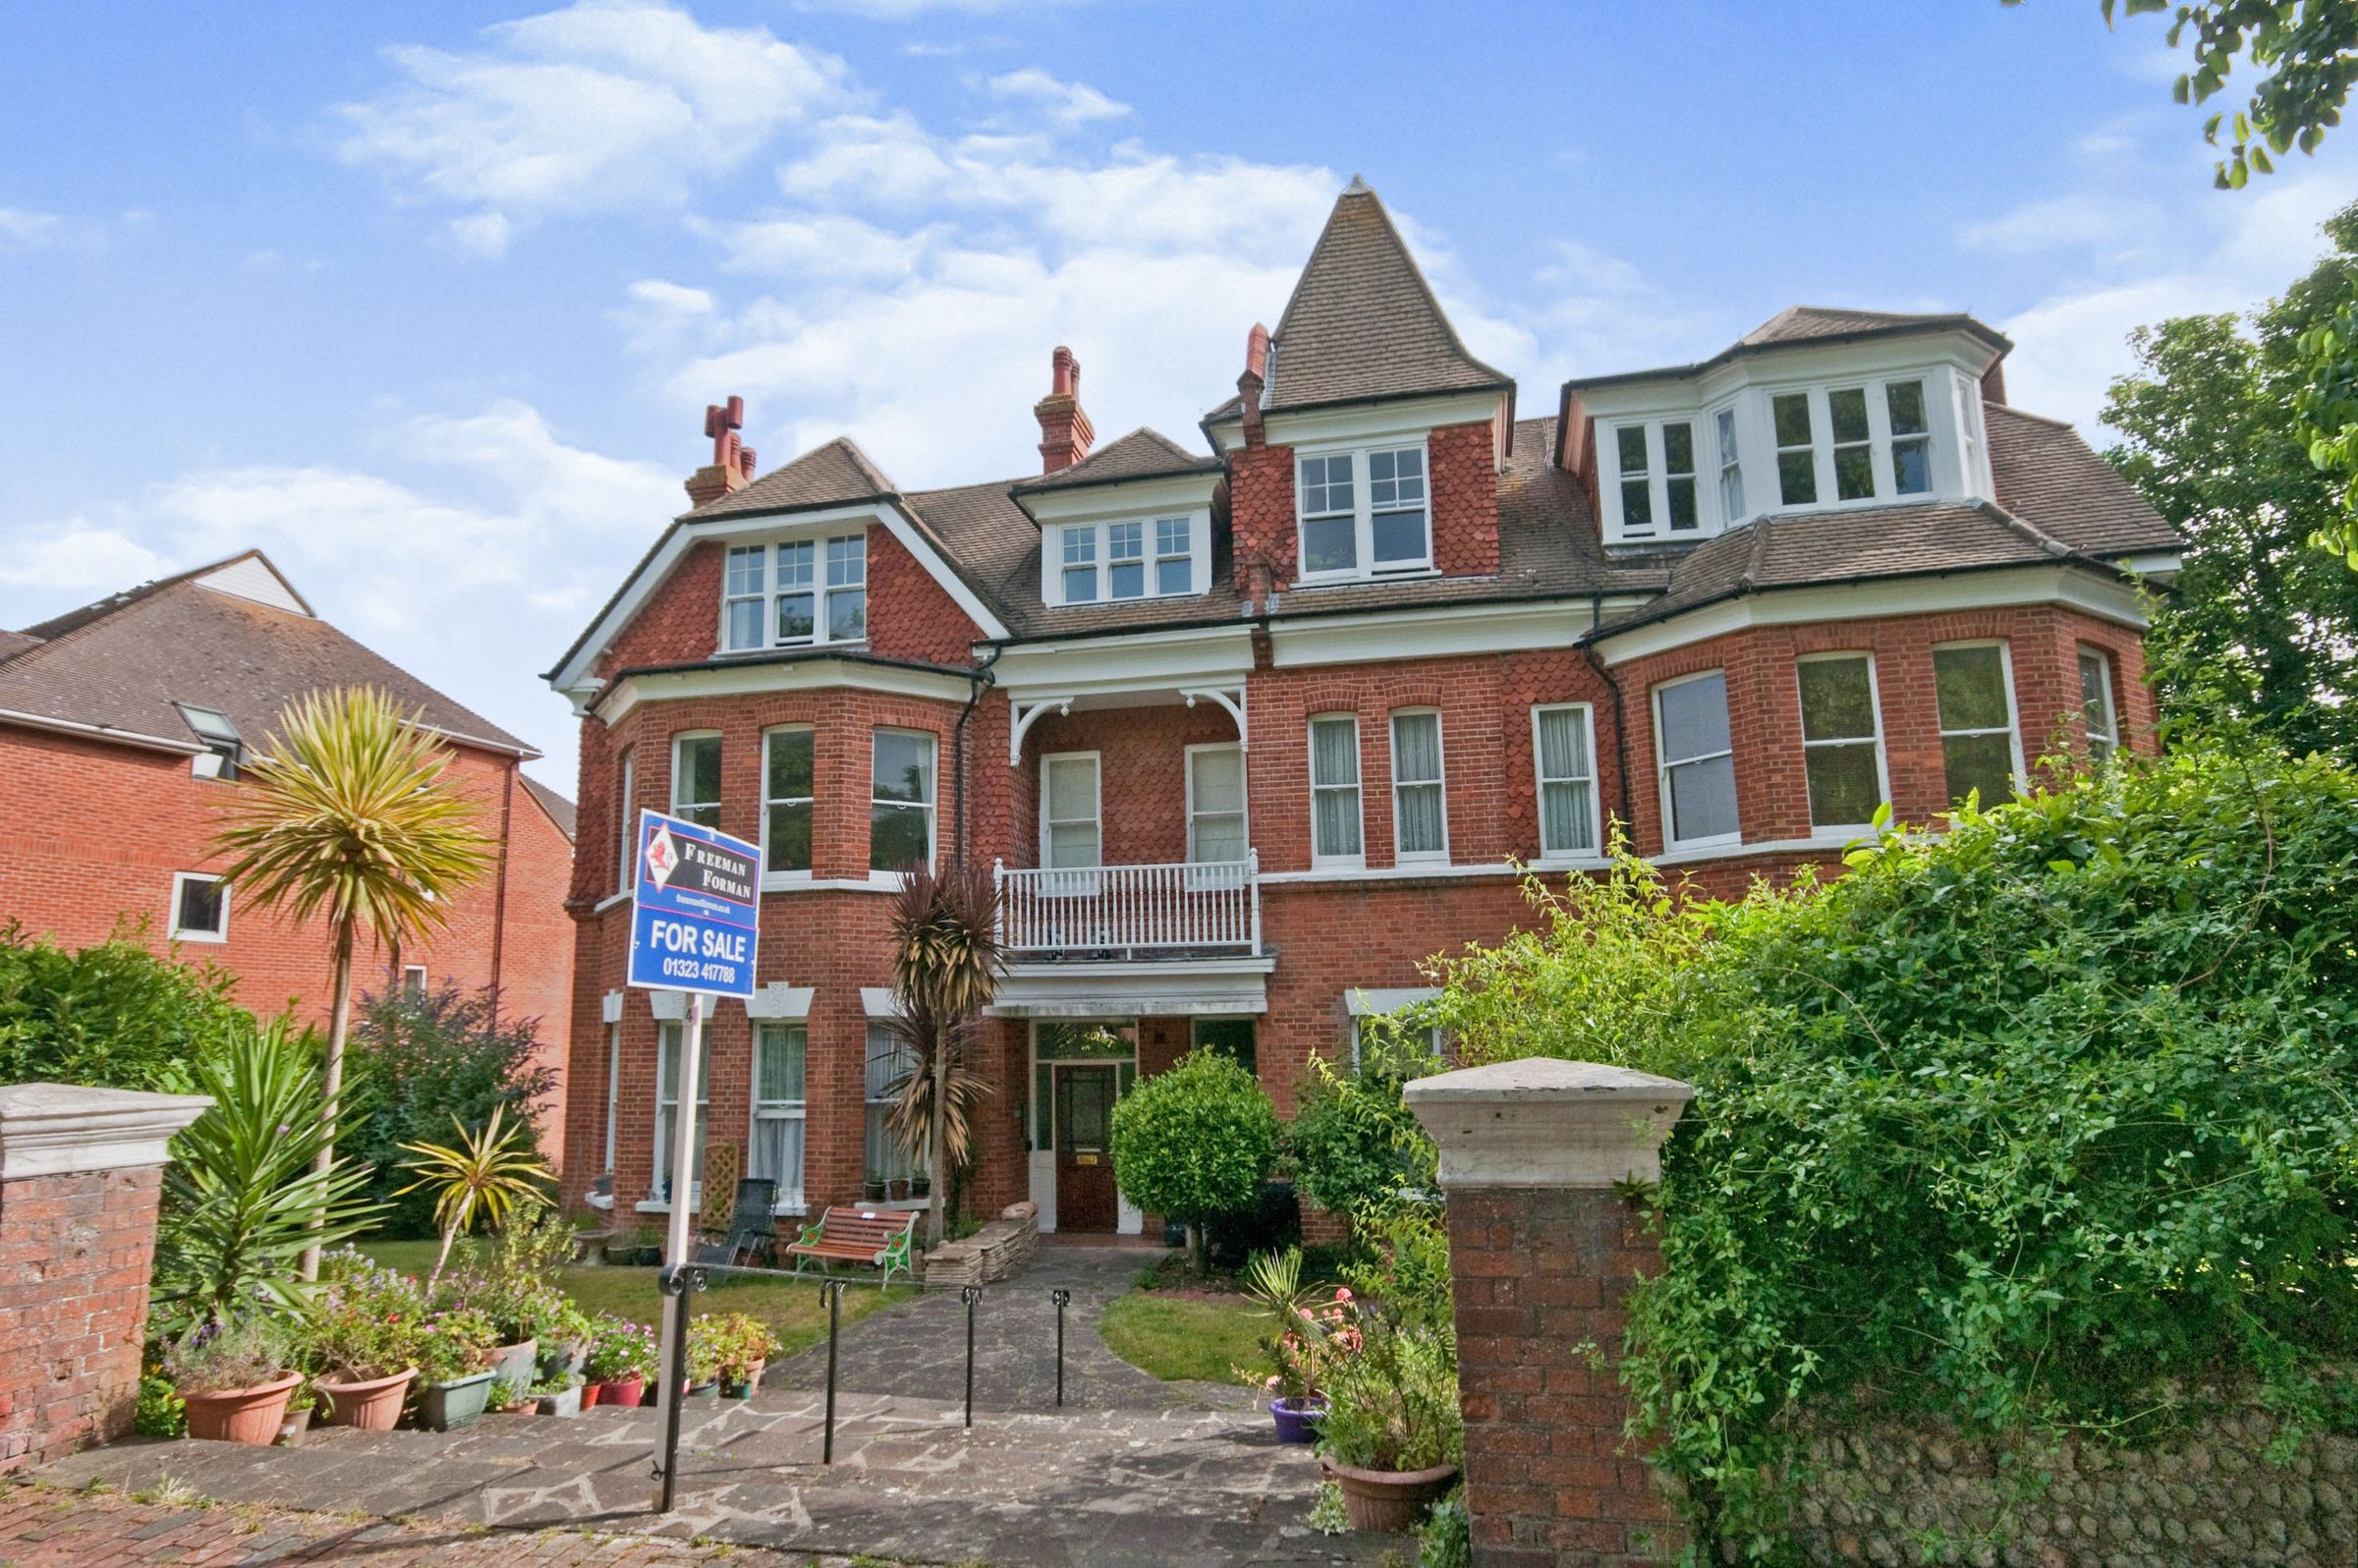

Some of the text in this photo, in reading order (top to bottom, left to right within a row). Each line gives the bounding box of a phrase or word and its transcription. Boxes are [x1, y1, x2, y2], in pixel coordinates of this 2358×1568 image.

[684, 843, 746, 876] FREEMAN
[702, 869, 751, 899] FORMAN
[650, 920, 746, 963] FOR SALE
[663, 957, 735, 983] 01323 417788
